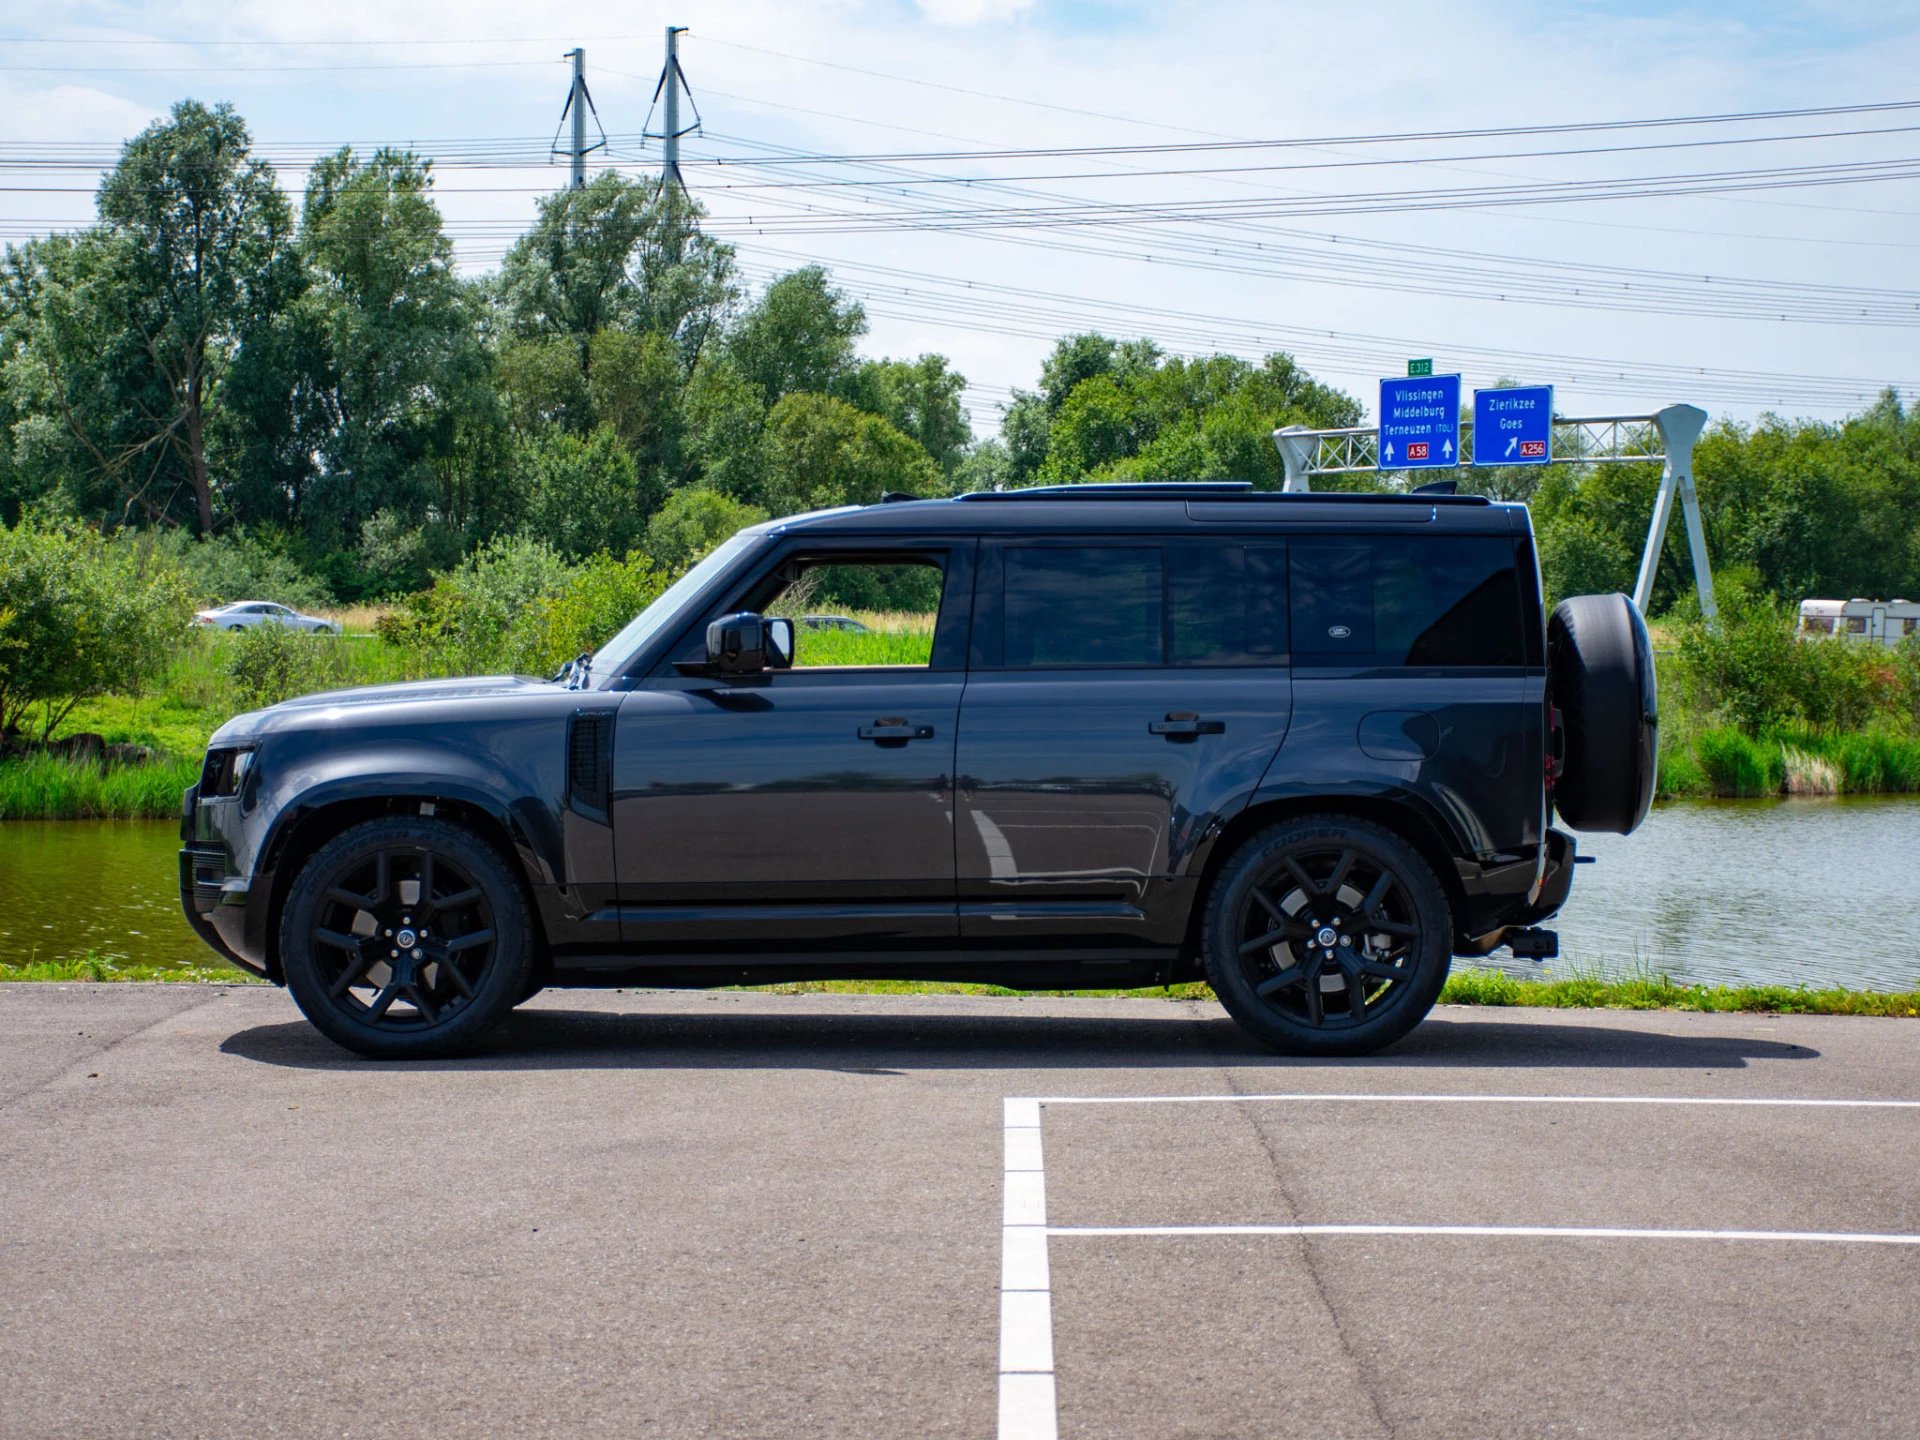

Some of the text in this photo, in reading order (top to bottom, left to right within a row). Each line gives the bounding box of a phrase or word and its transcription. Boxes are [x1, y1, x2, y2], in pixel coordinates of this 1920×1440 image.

[1409, 362, 1430, 374] E312
[1395, 389, 1444, 403] Vlissingen
[1489, 398, 1536, 411] Zierikzee
[1393, 405, 1445, 420] Middelburg
[1384, 423, 1432, 436] Terneuzen
[1500, 417, 1523, 430] Goes
[1409, 446, 1427, 457] A58
[1521, 443, 1544, 455] A256
[1262, 827, 1346, 857] COOPER
